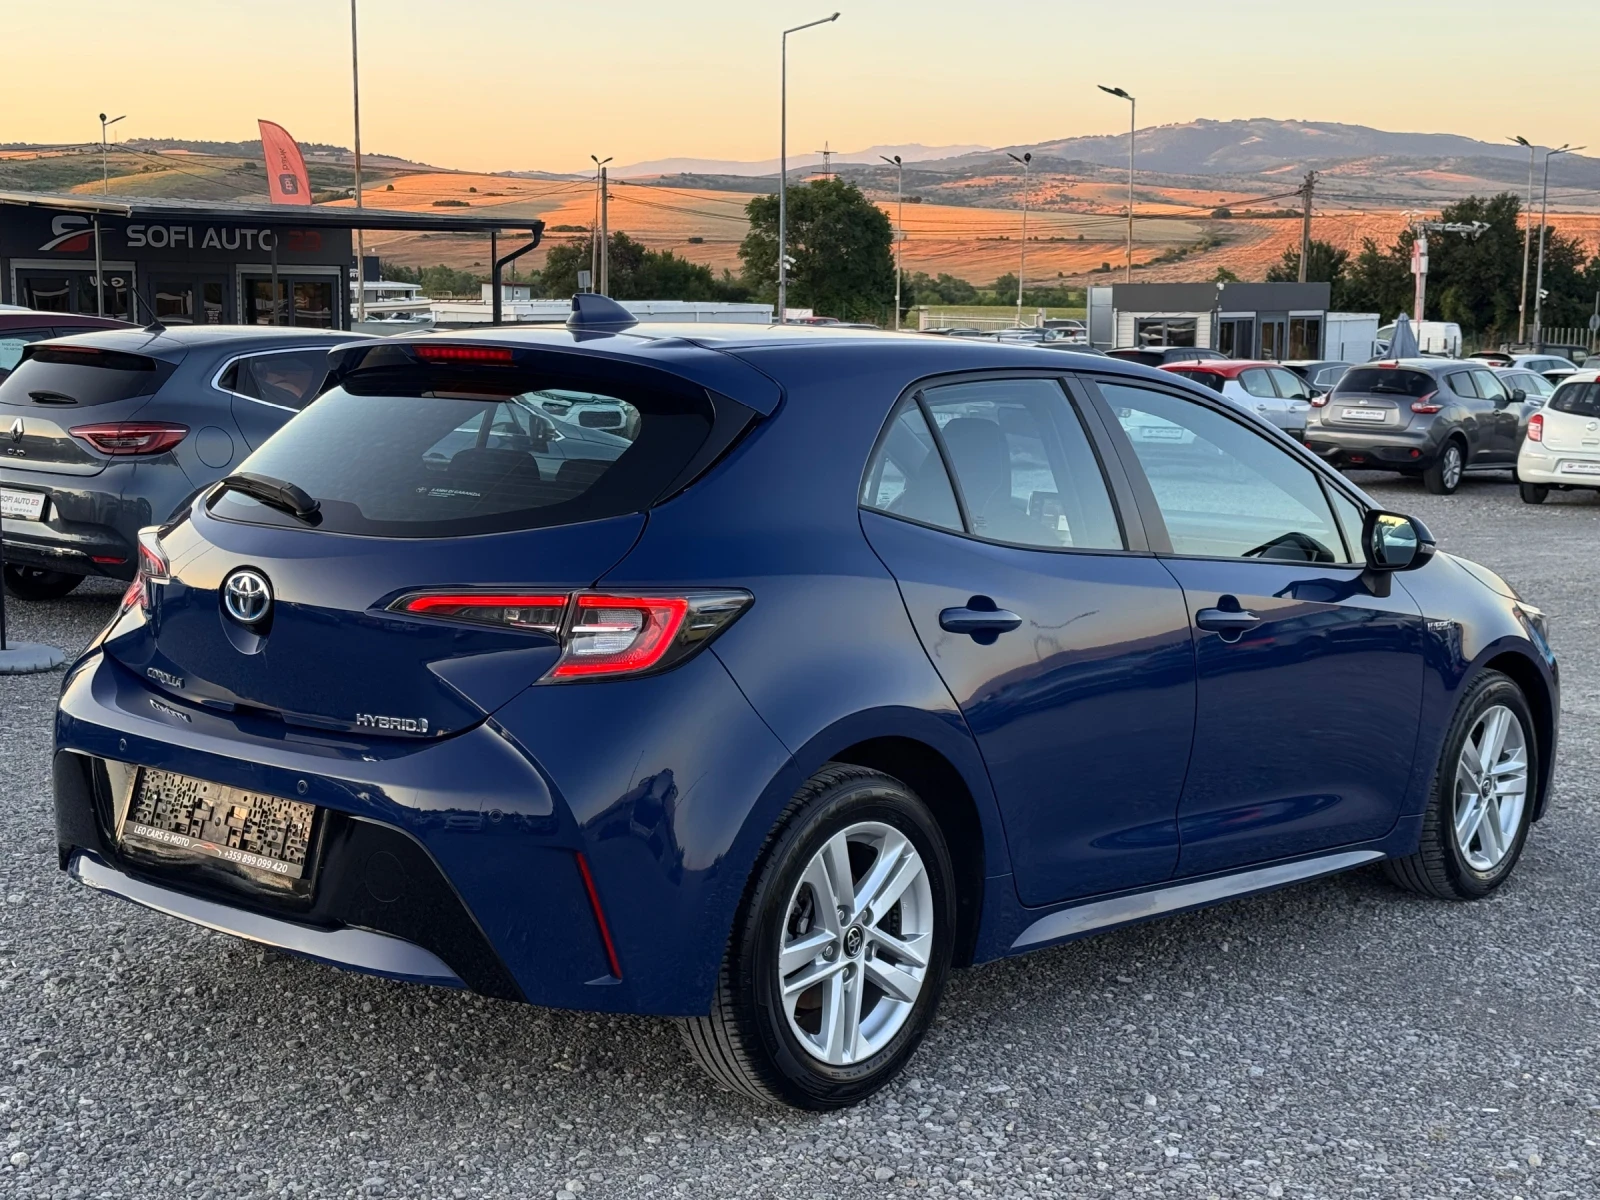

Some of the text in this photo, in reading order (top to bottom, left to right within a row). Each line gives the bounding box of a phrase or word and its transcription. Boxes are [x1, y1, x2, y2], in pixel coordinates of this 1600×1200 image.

[126, 224, 322, 251] SOFI AUTO 23
[13, 496, 31, 505] AUTO
[147, 667, 185, 689] COROLLA
[356, 713, 417, 732] HYBRID
[134, 826, 288, 873] LEO CARS & MOTO +359 899 099 420
